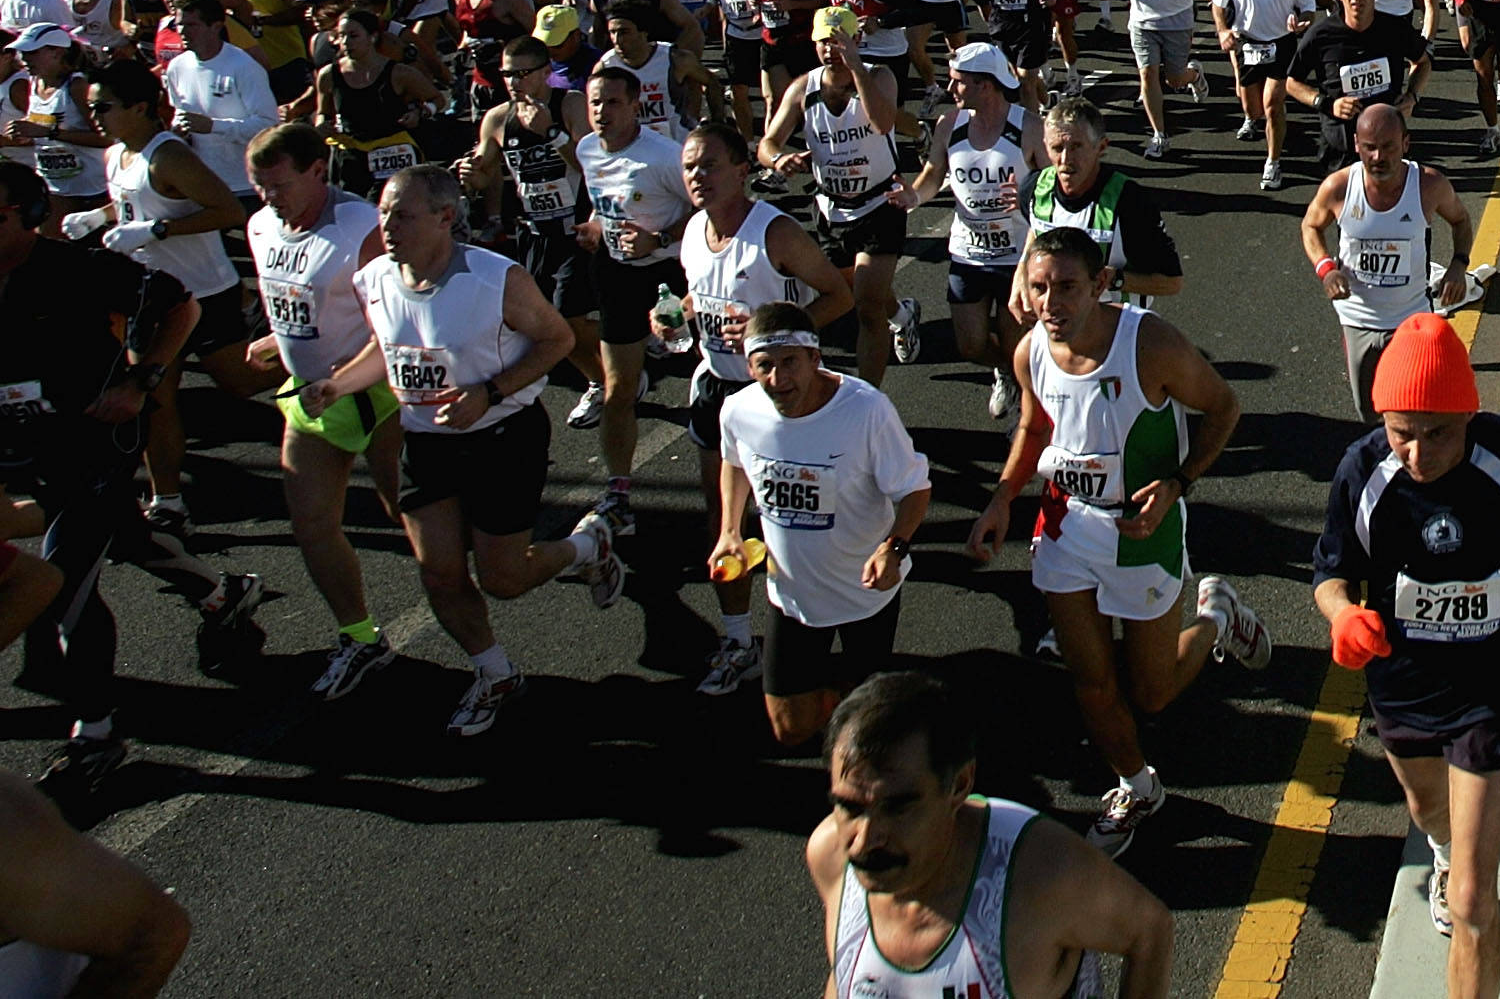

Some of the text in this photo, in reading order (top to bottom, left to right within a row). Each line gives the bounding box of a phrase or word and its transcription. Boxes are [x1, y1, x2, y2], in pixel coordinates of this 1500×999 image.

[815, 122, 873, 145] ENDRIK
[954, 166, 1016, 185] COLM
[1360, 241, 1383, 252] ING
[1359, 252, 1401, 274] 8077
[391, 363, 450, 389] 16842
[1053, 468, 1108, 498] 4807
[763, 480, 820, 512] 2665
[1416, 584, 1458, 598] ING
